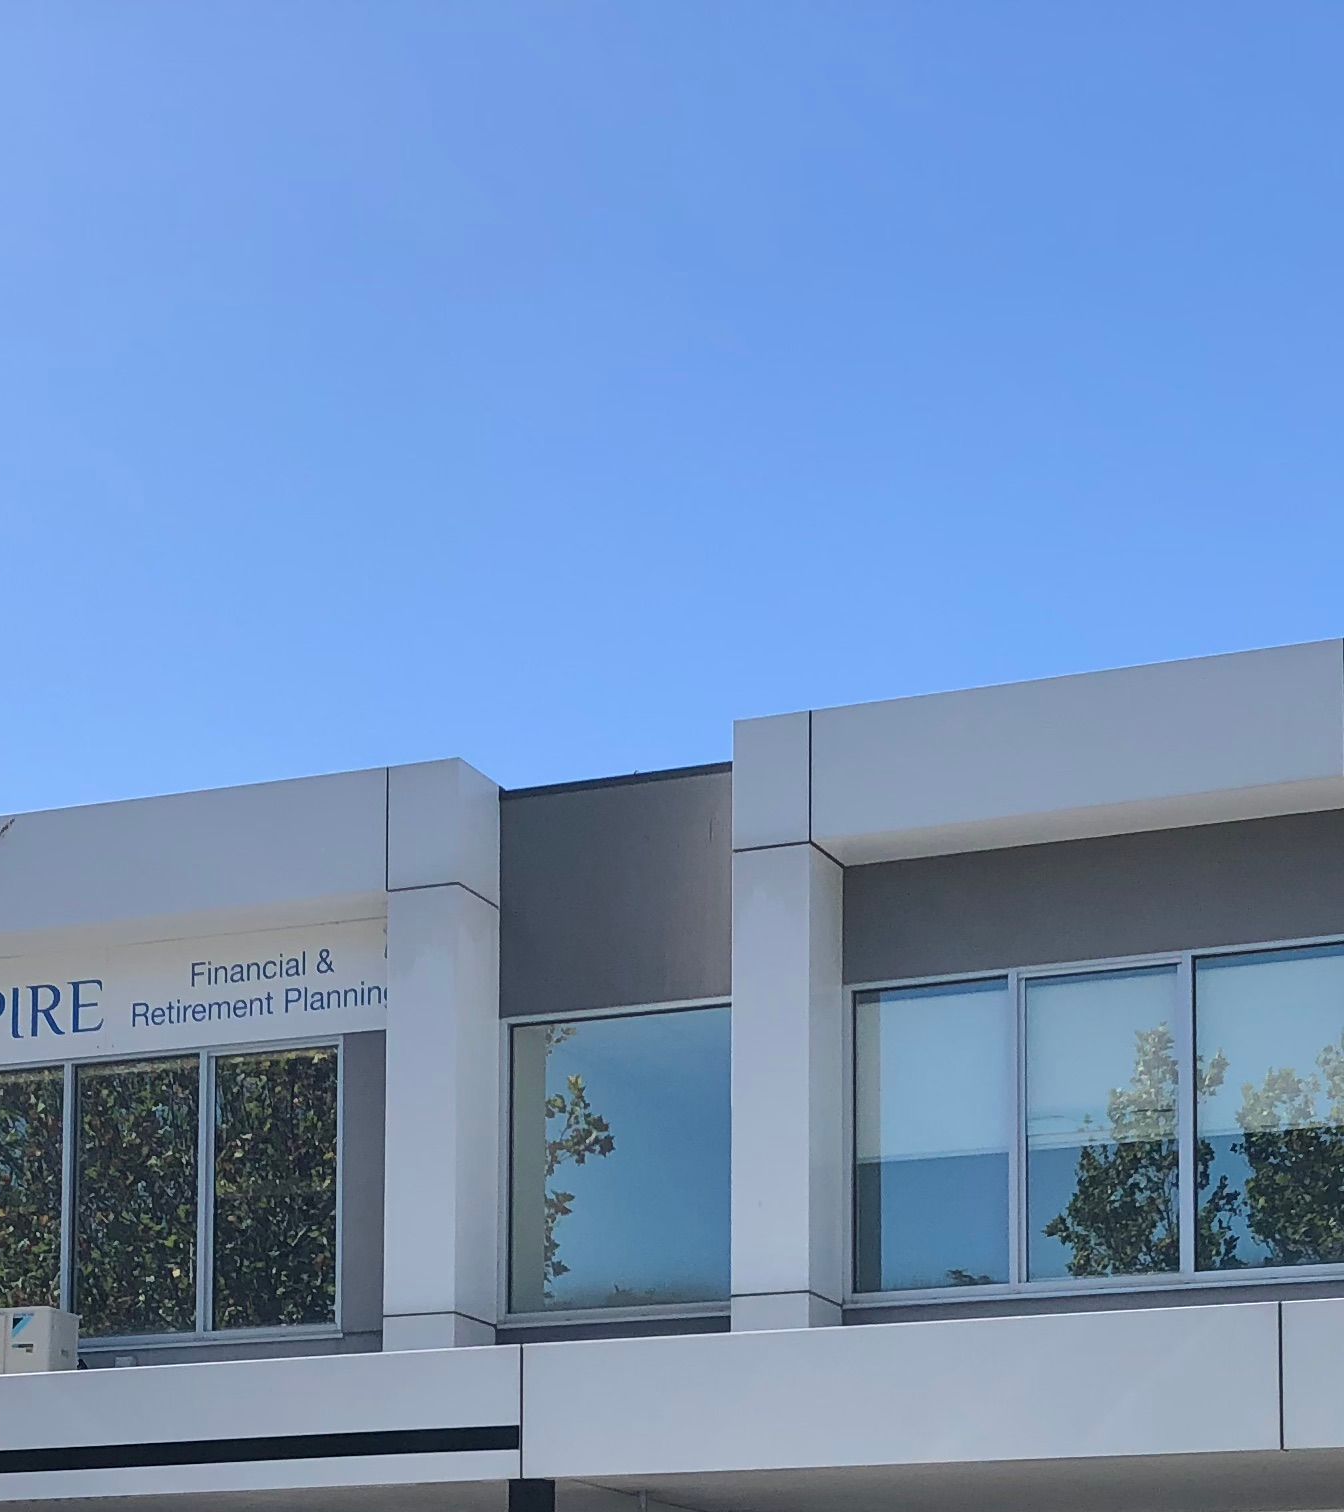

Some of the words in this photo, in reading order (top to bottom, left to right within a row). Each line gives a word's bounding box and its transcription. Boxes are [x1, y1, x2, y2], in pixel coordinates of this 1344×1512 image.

[190, 949, 306, 988] Financial
[316, 947, 335, 974] &
[131, 993, 274, 1029] Retirement
[284, 981, 387, 1016] Plannin
